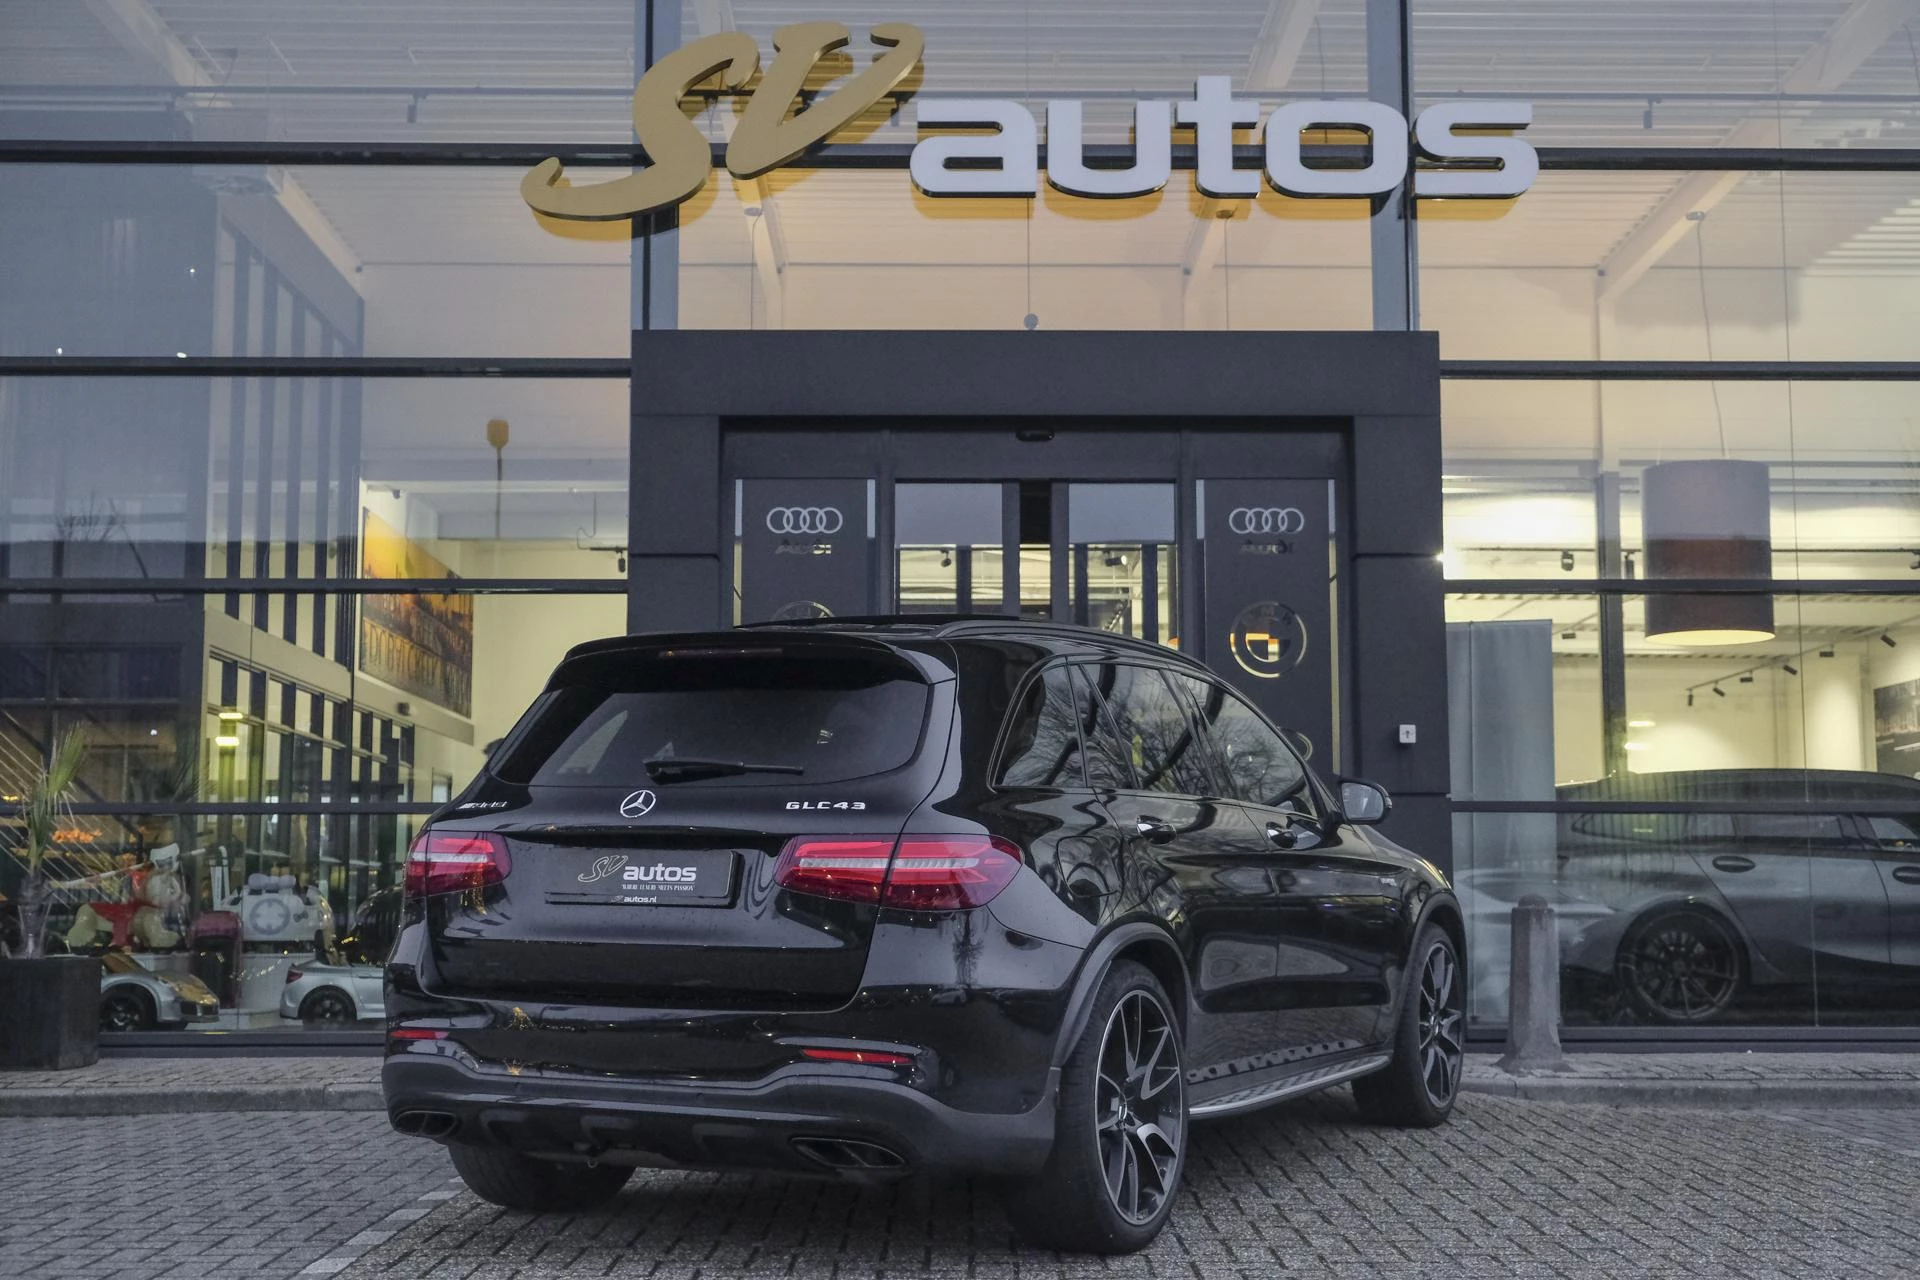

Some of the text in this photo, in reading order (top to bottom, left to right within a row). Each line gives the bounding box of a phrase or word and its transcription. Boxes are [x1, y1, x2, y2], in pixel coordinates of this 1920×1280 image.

[909, 75, 1540, 200] autos
[785, 801, 867, 810] GLC43
[623, 863, 697, 881] autos
